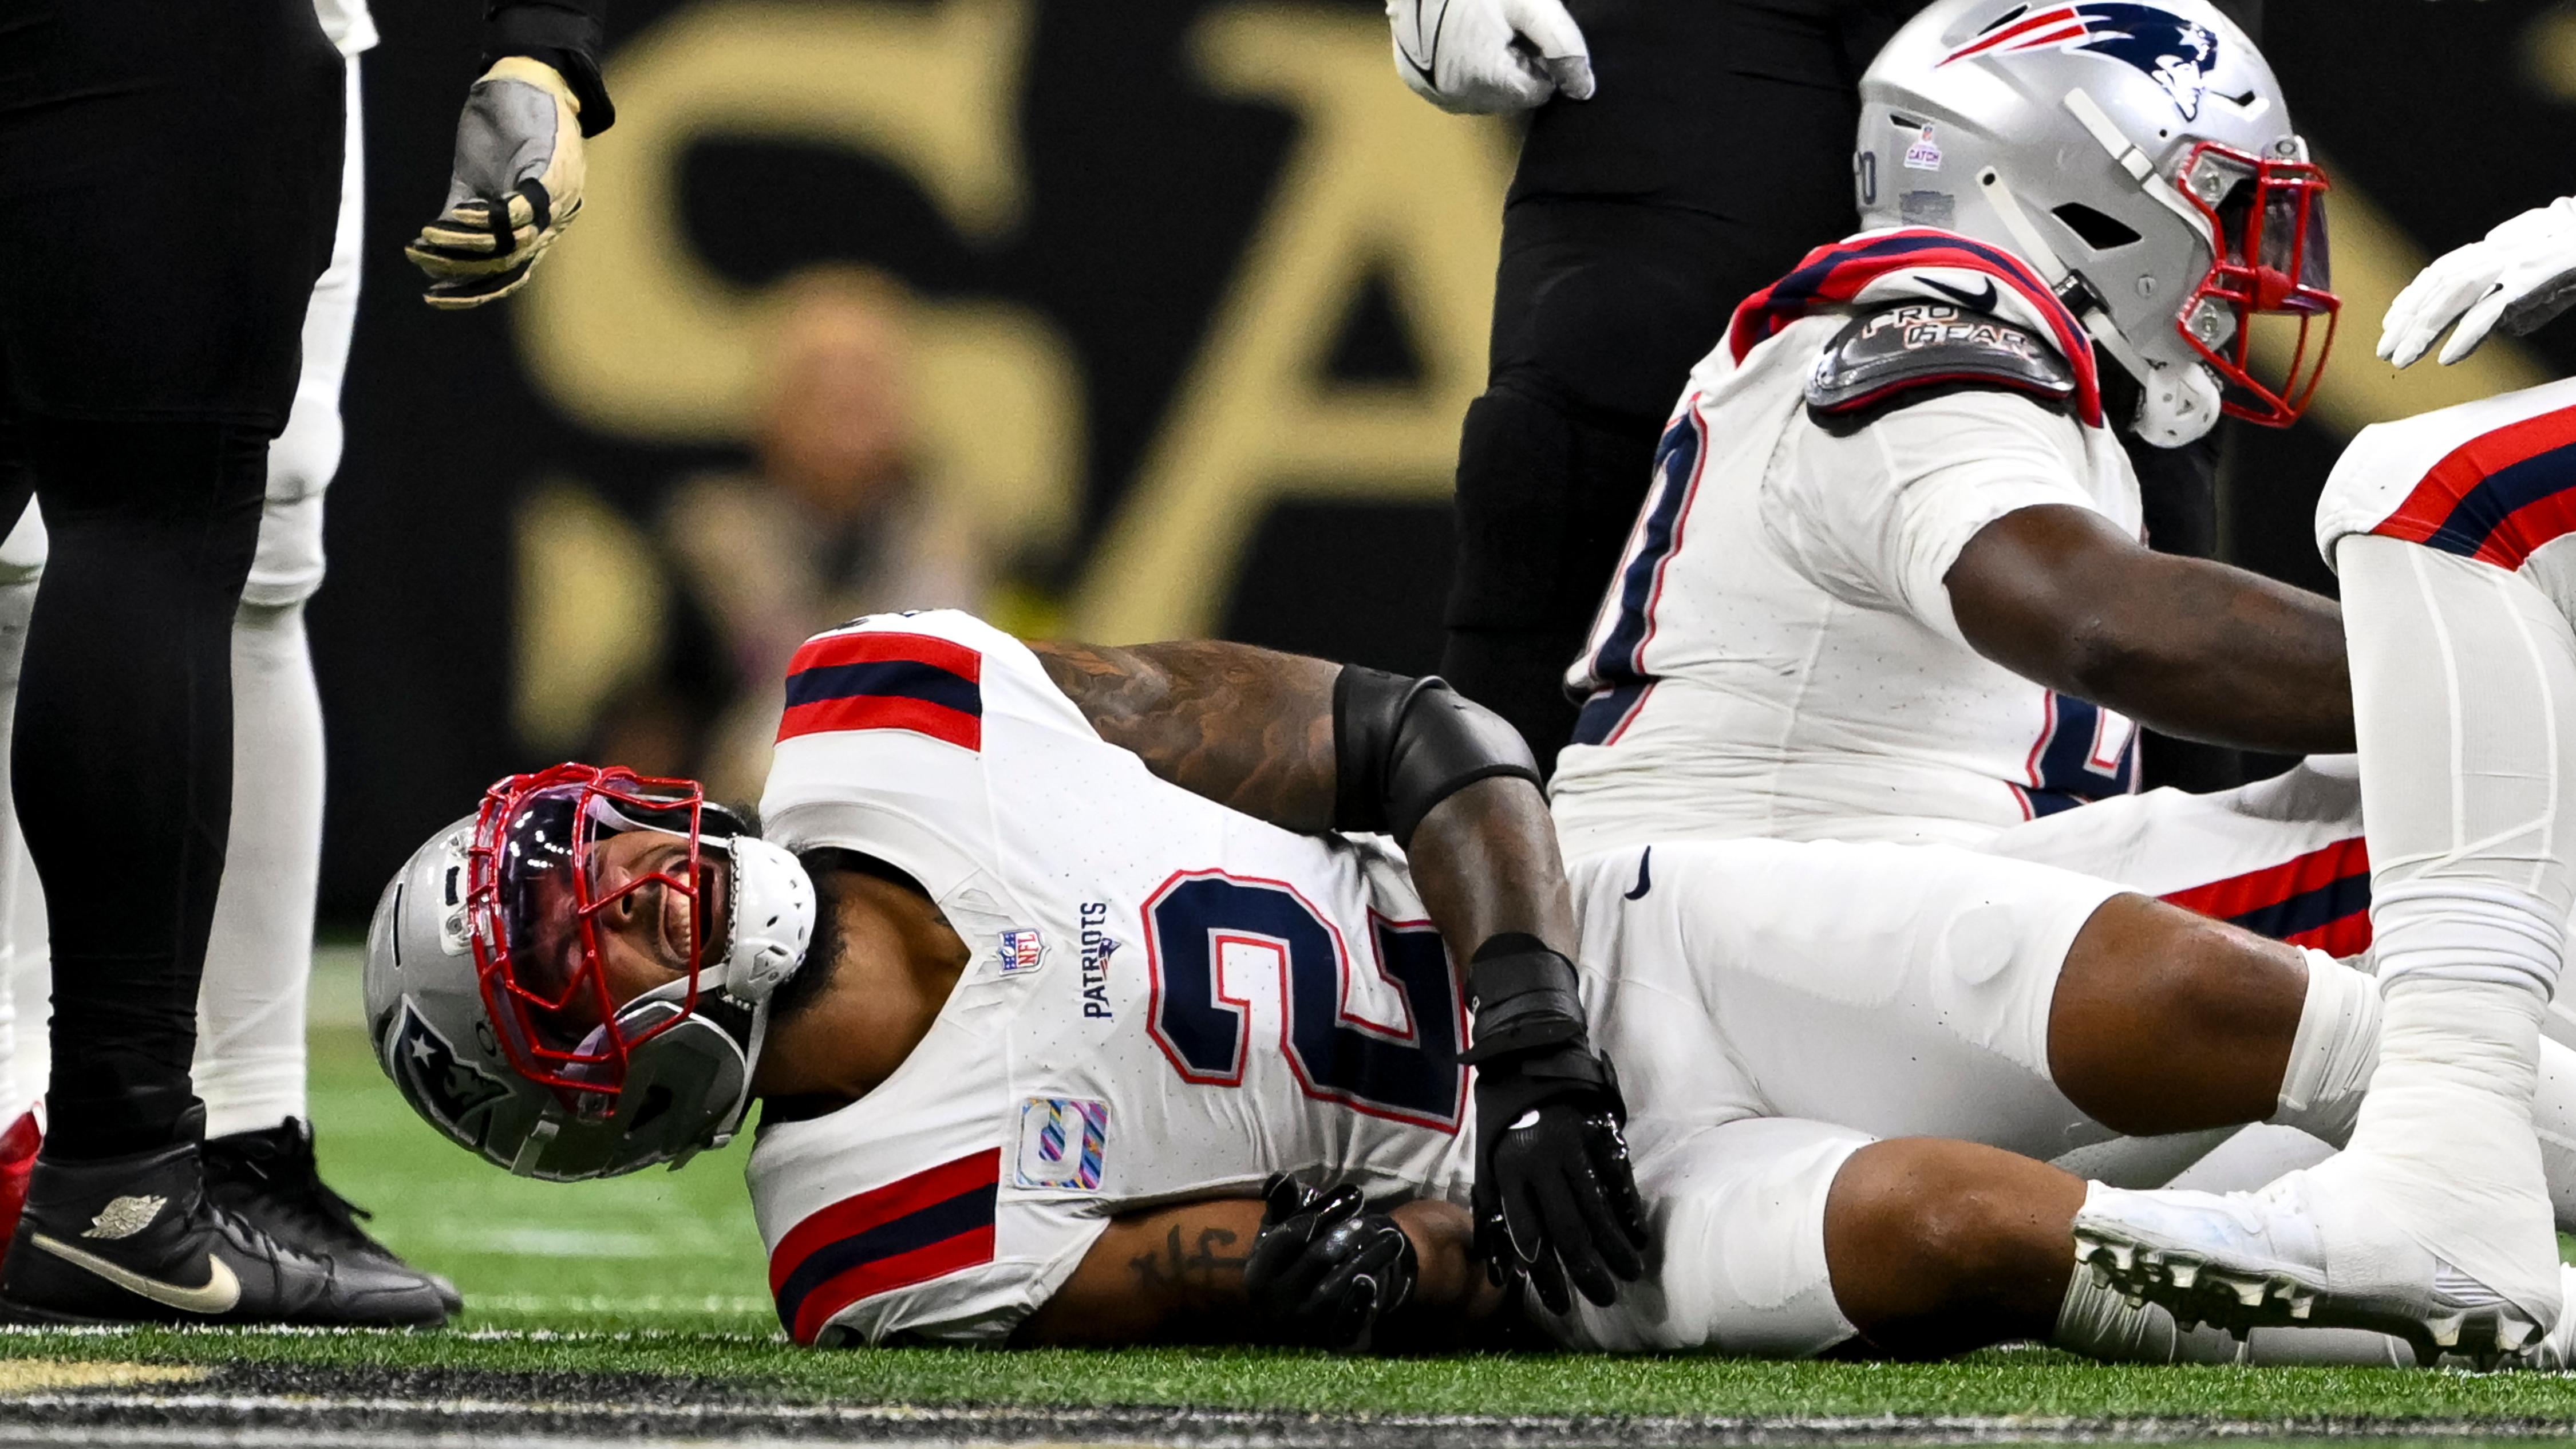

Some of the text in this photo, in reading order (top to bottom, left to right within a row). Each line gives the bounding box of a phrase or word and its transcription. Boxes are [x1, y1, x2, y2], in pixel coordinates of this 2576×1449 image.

[1862, 304, 1959, 339] PRO
[1903, 322, 2040, 365] GEAR
[1017, 933, 1040, 966] NFL
[1080, 902, 1113, 1018] PATRIOTS
[1140, 867, 1469, 1135] 2
